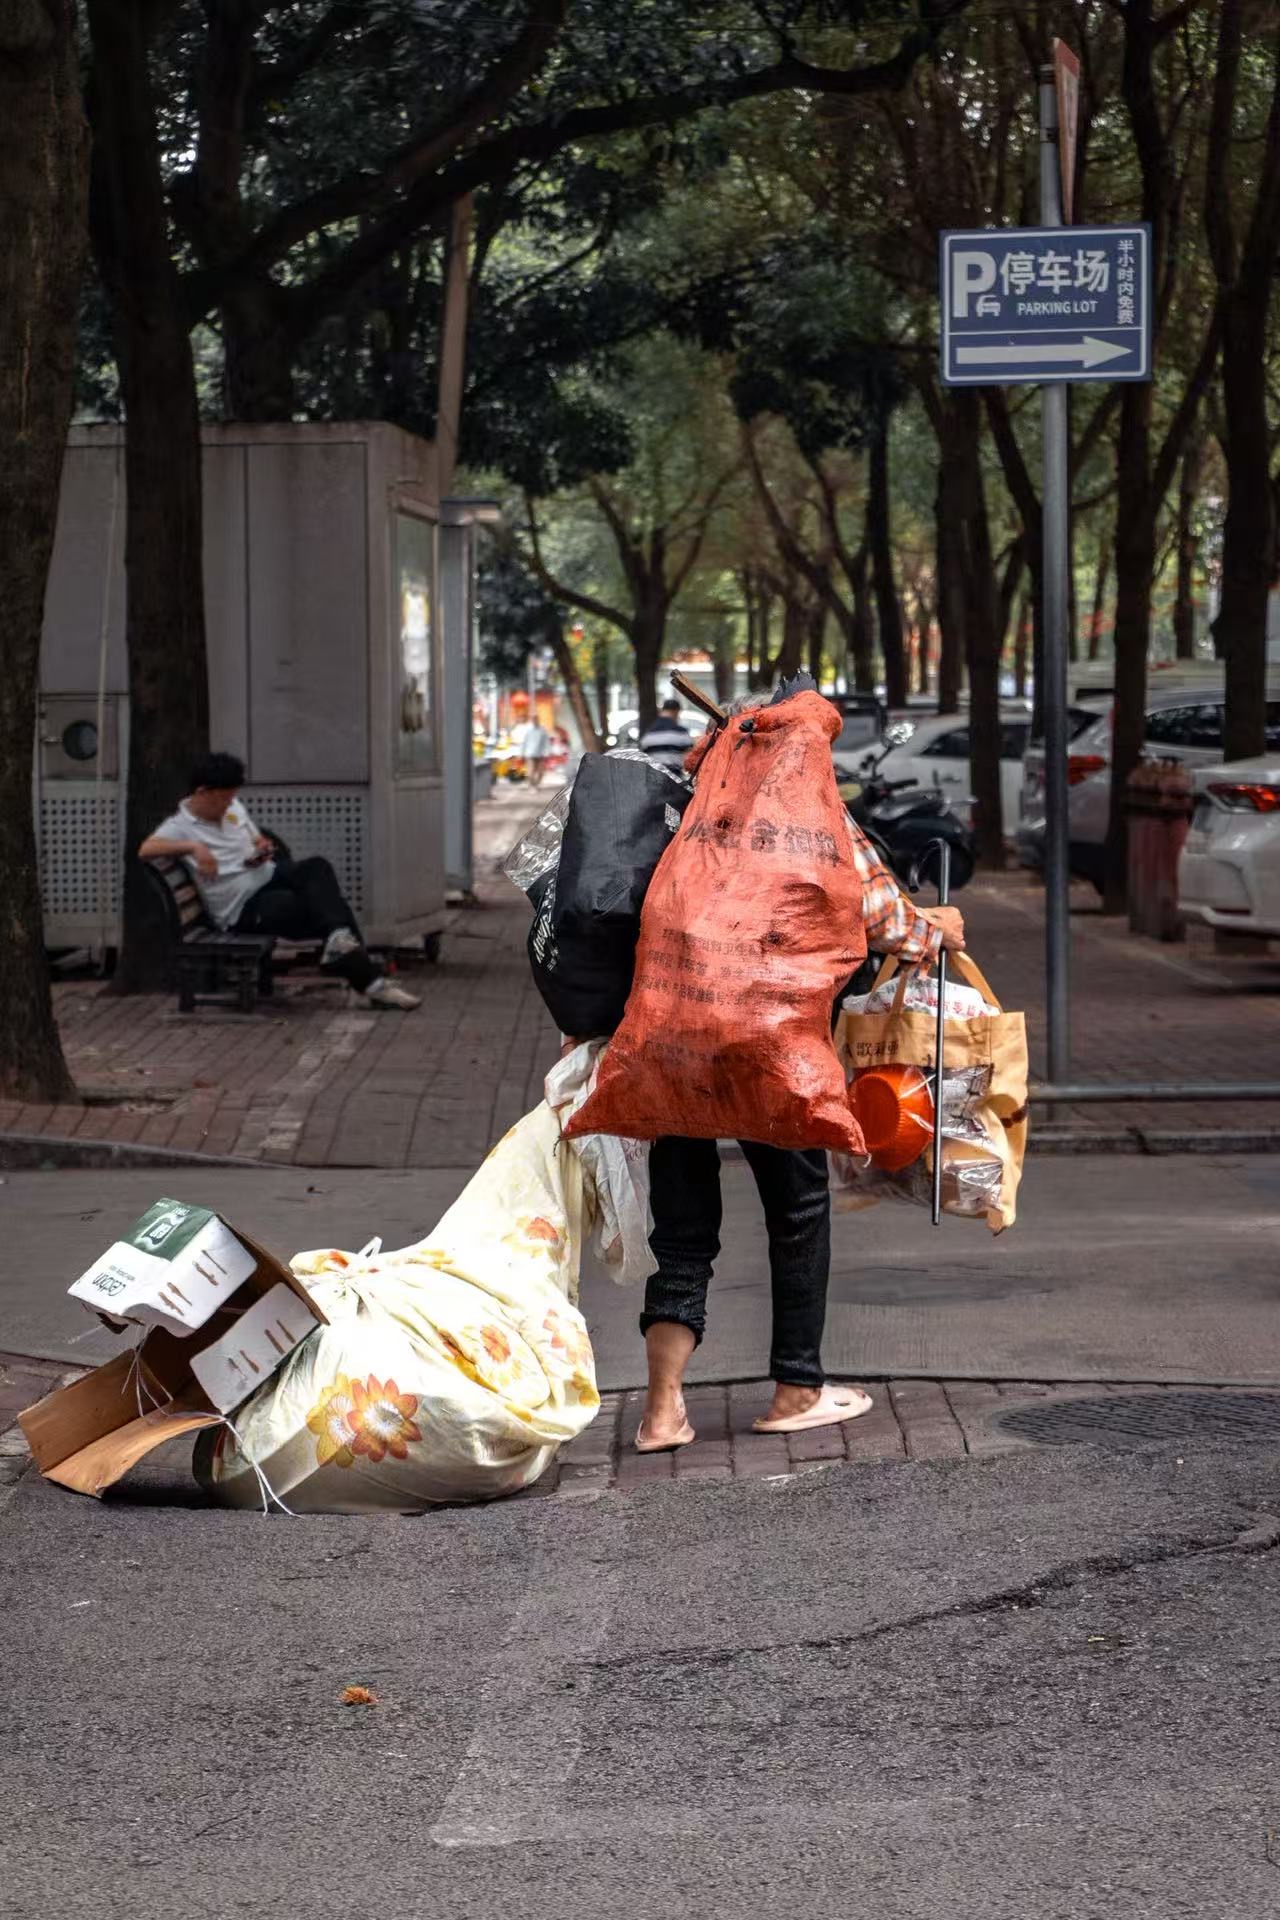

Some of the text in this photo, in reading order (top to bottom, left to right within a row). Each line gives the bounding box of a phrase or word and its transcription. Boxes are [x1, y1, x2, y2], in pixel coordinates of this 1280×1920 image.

[953, 252, 996, 318] P
[1000, 249, 1110, 296] 停车场
[1117, 240, 1134, 324] 半小时内免费
[1017, 300, 1098, 316] PARKING LOT
